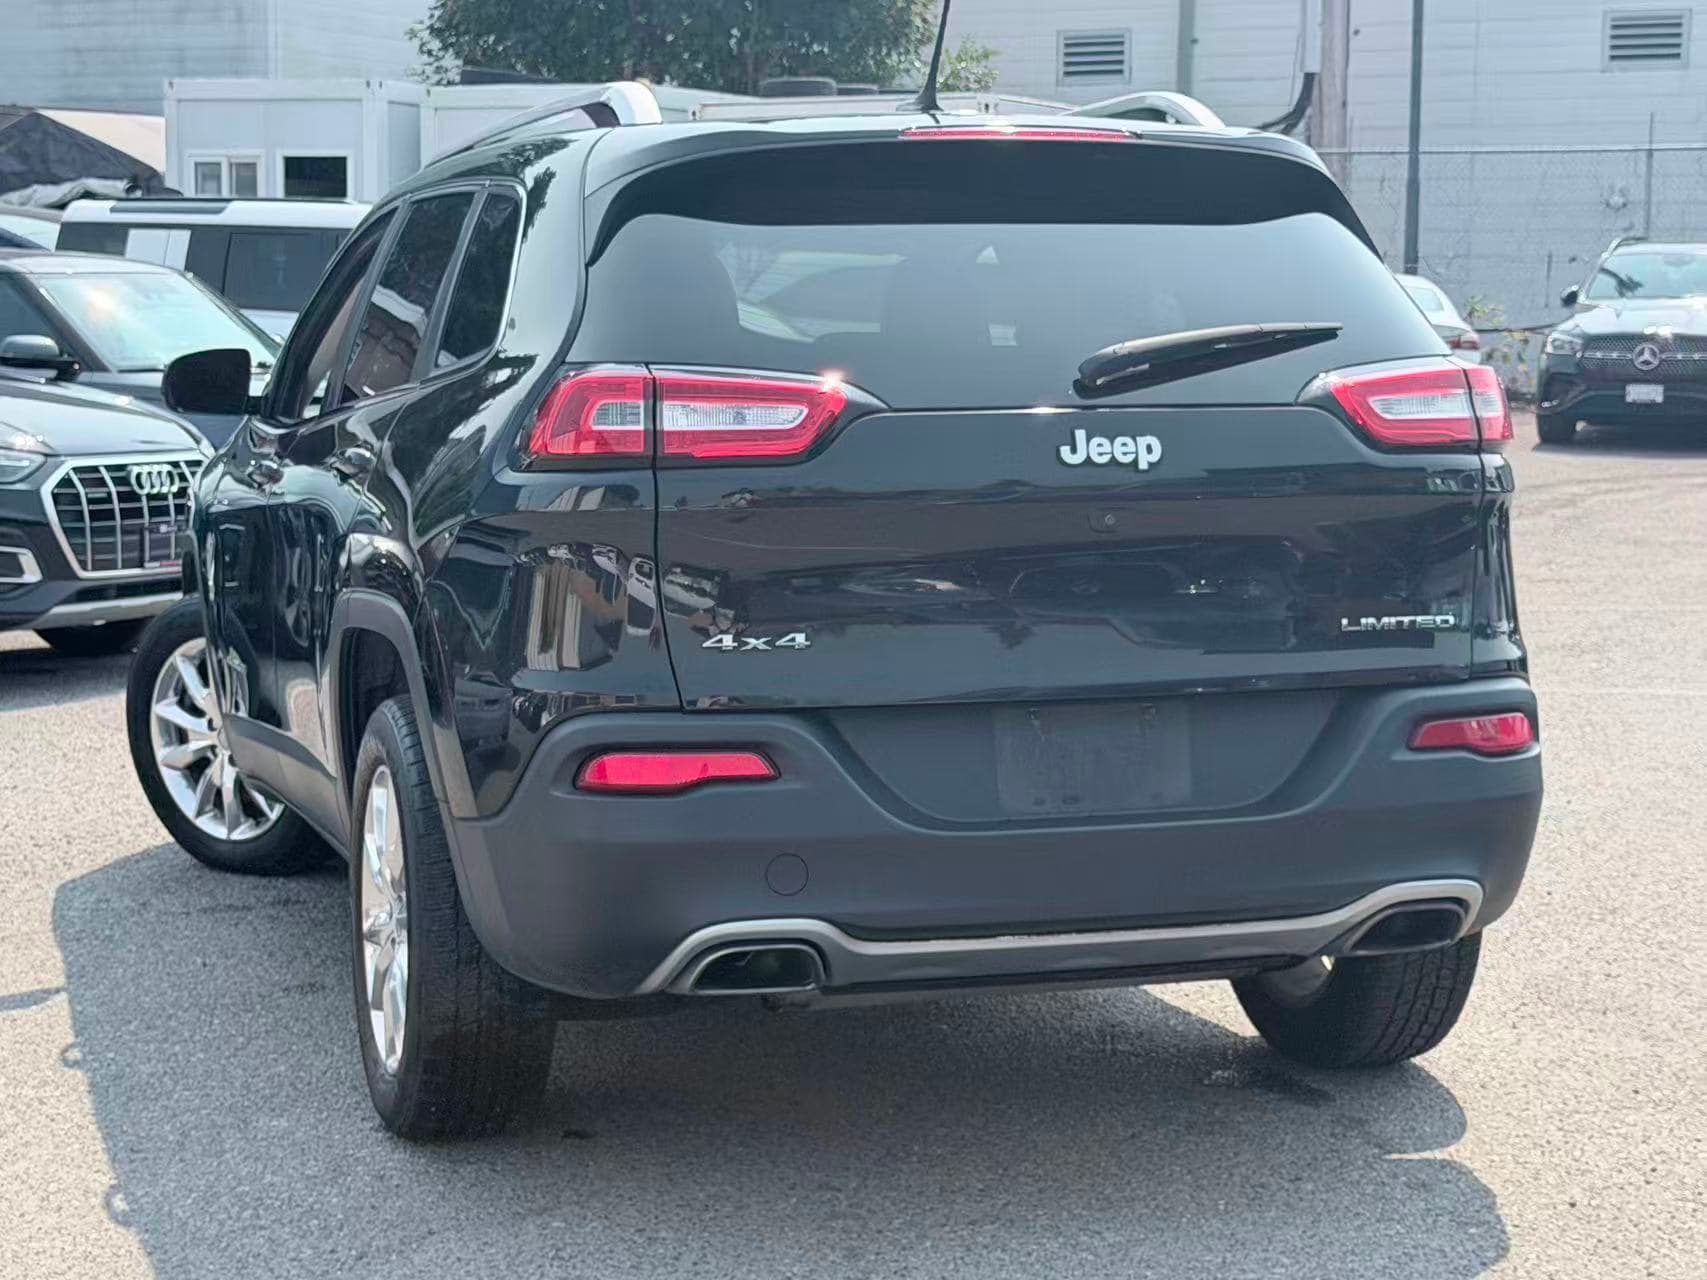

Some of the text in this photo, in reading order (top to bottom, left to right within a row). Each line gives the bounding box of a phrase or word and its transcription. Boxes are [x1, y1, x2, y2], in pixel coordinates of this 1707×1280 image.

[1059, 429, 1162, 470] Jeep
[1341, 614, 1455, 631] LIMITED
[702, 633, 811, 650] 4x4
